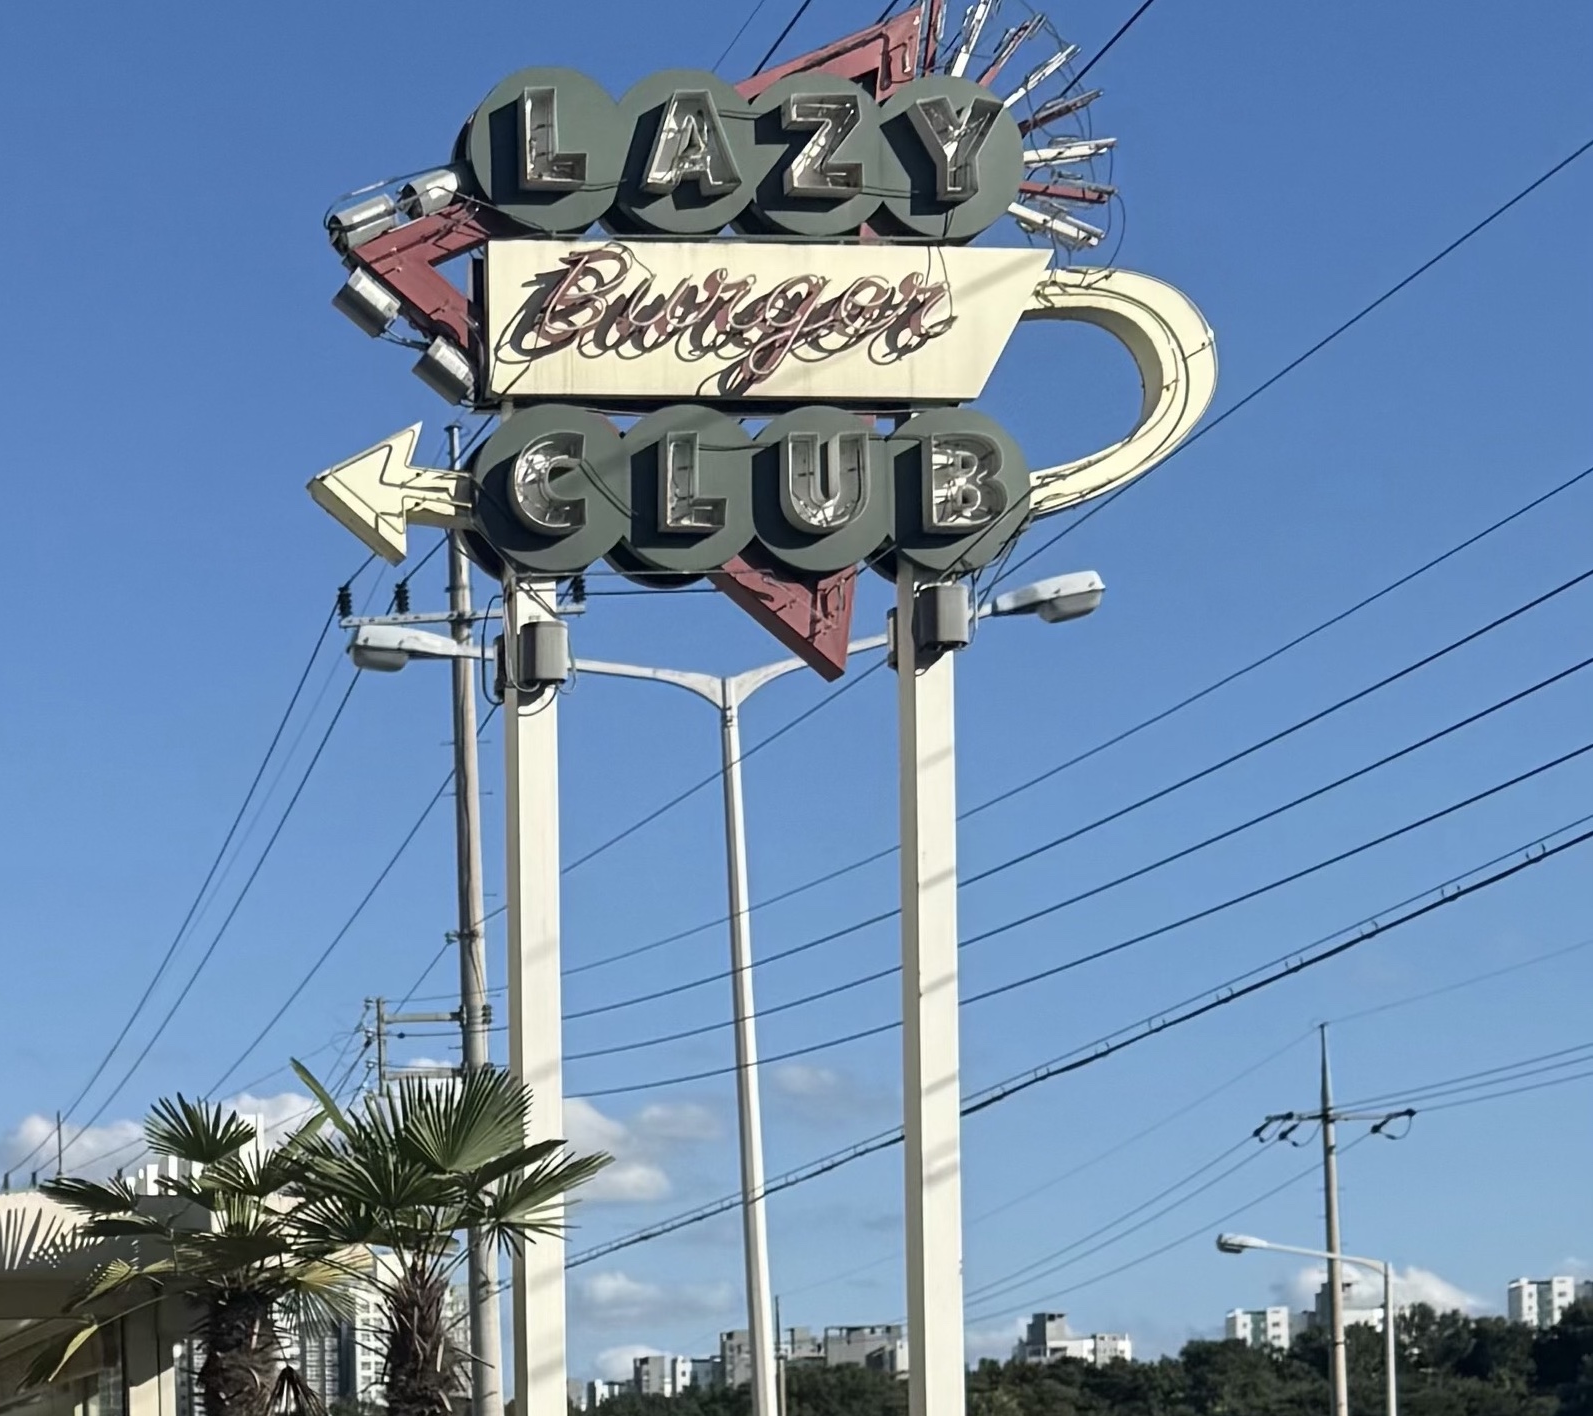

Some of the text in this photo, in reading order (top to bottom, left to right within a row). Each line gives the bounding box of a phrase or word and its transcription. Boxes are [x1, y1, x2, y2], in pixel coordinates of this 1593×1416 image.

[517, 84, 1008, 202] LAZY
[529, 244, 957, 386] Burger
[508, 429, 1011, 538] CLUB
